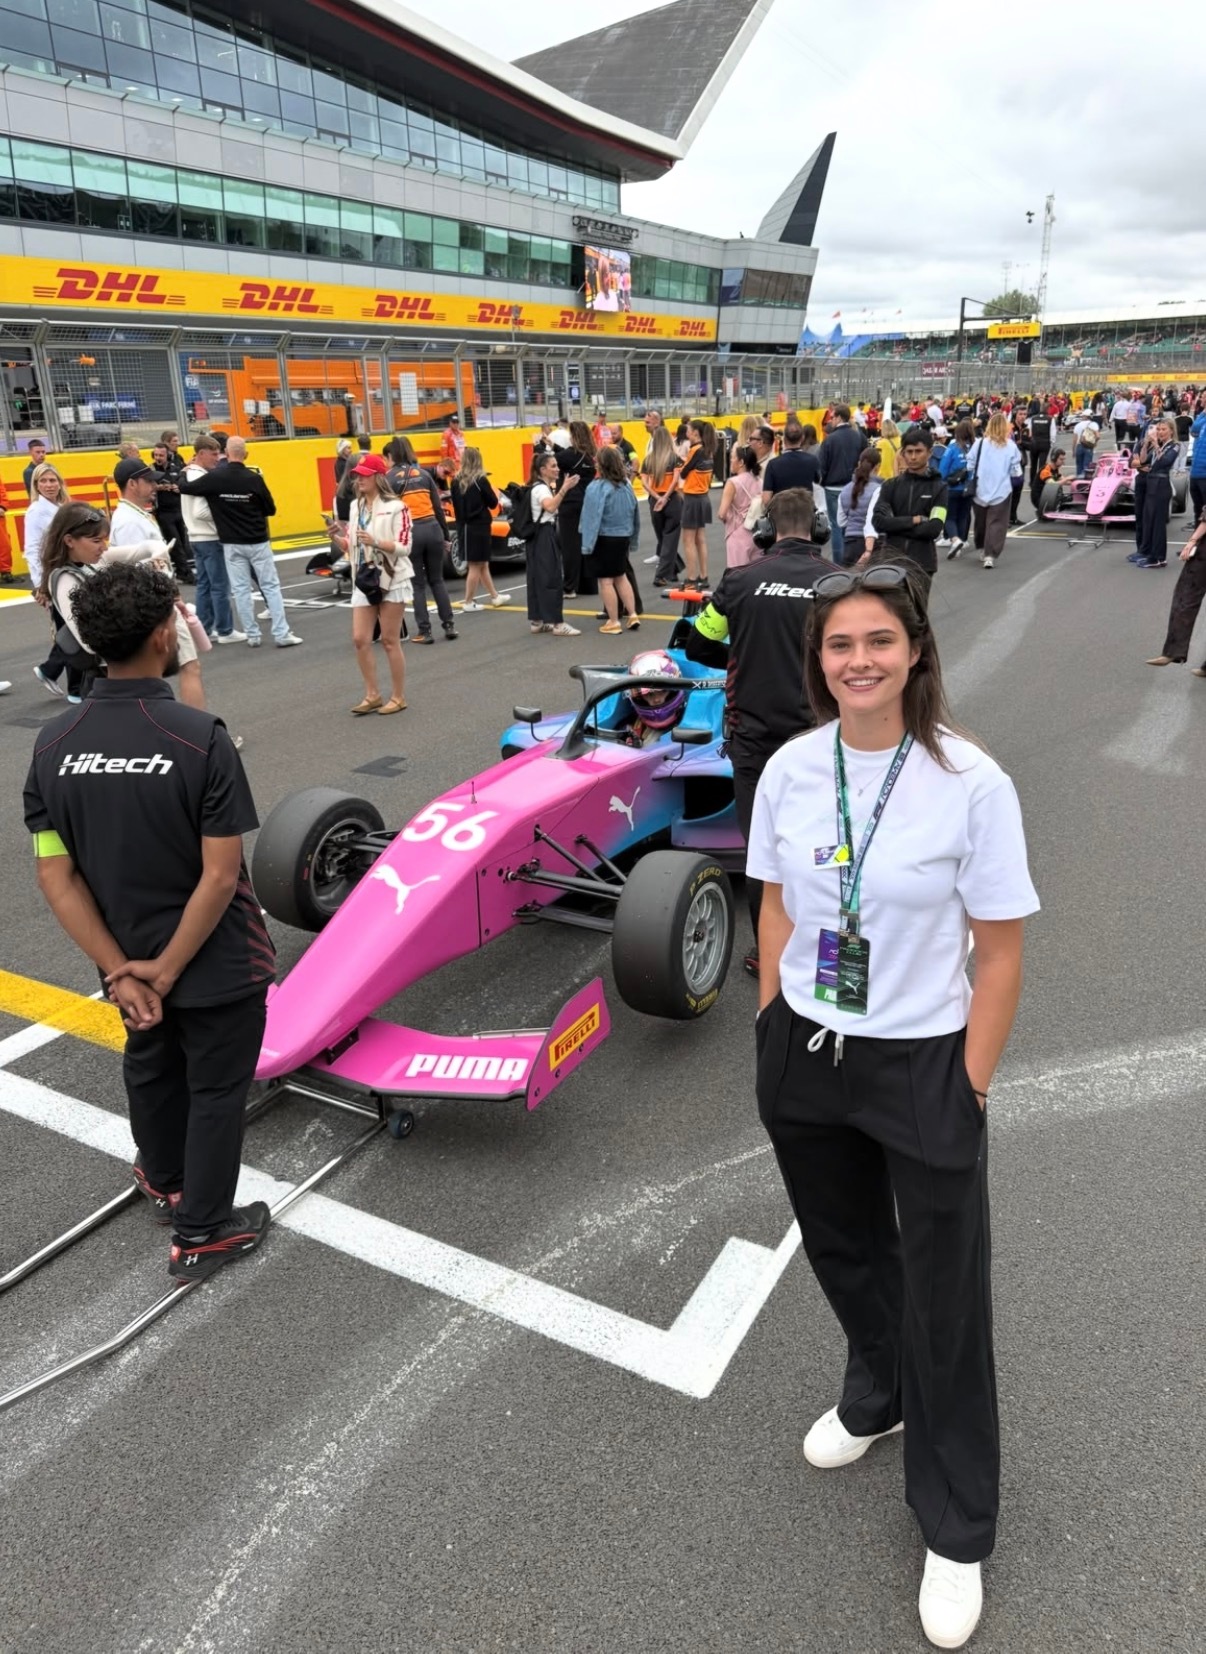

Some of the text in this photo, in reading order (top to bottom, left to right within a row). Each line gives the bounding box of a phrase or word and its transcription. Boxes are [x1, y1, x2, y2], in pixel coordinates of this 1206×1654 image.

[56, 268, 167, 305] DHL
[239, 282, 320, 314] DHL
[374, 294, 435, 320] DHL
[477, 302, 525, 326] DHL
[559, 310, 599, 331] DHL
[625, 315, 657, 333] DHL
[679, 320, 706, 337] DHL
[754, 581, 815, 599] Hitec
[58, 753, 174, 776] Hitech
[402, 801, 500, 852] 56
[697, 866, 722, 885] ZERO
[554, 1010, 597, 1063] PIRELLI
[404, 1053, 530, 1081] PUMA
